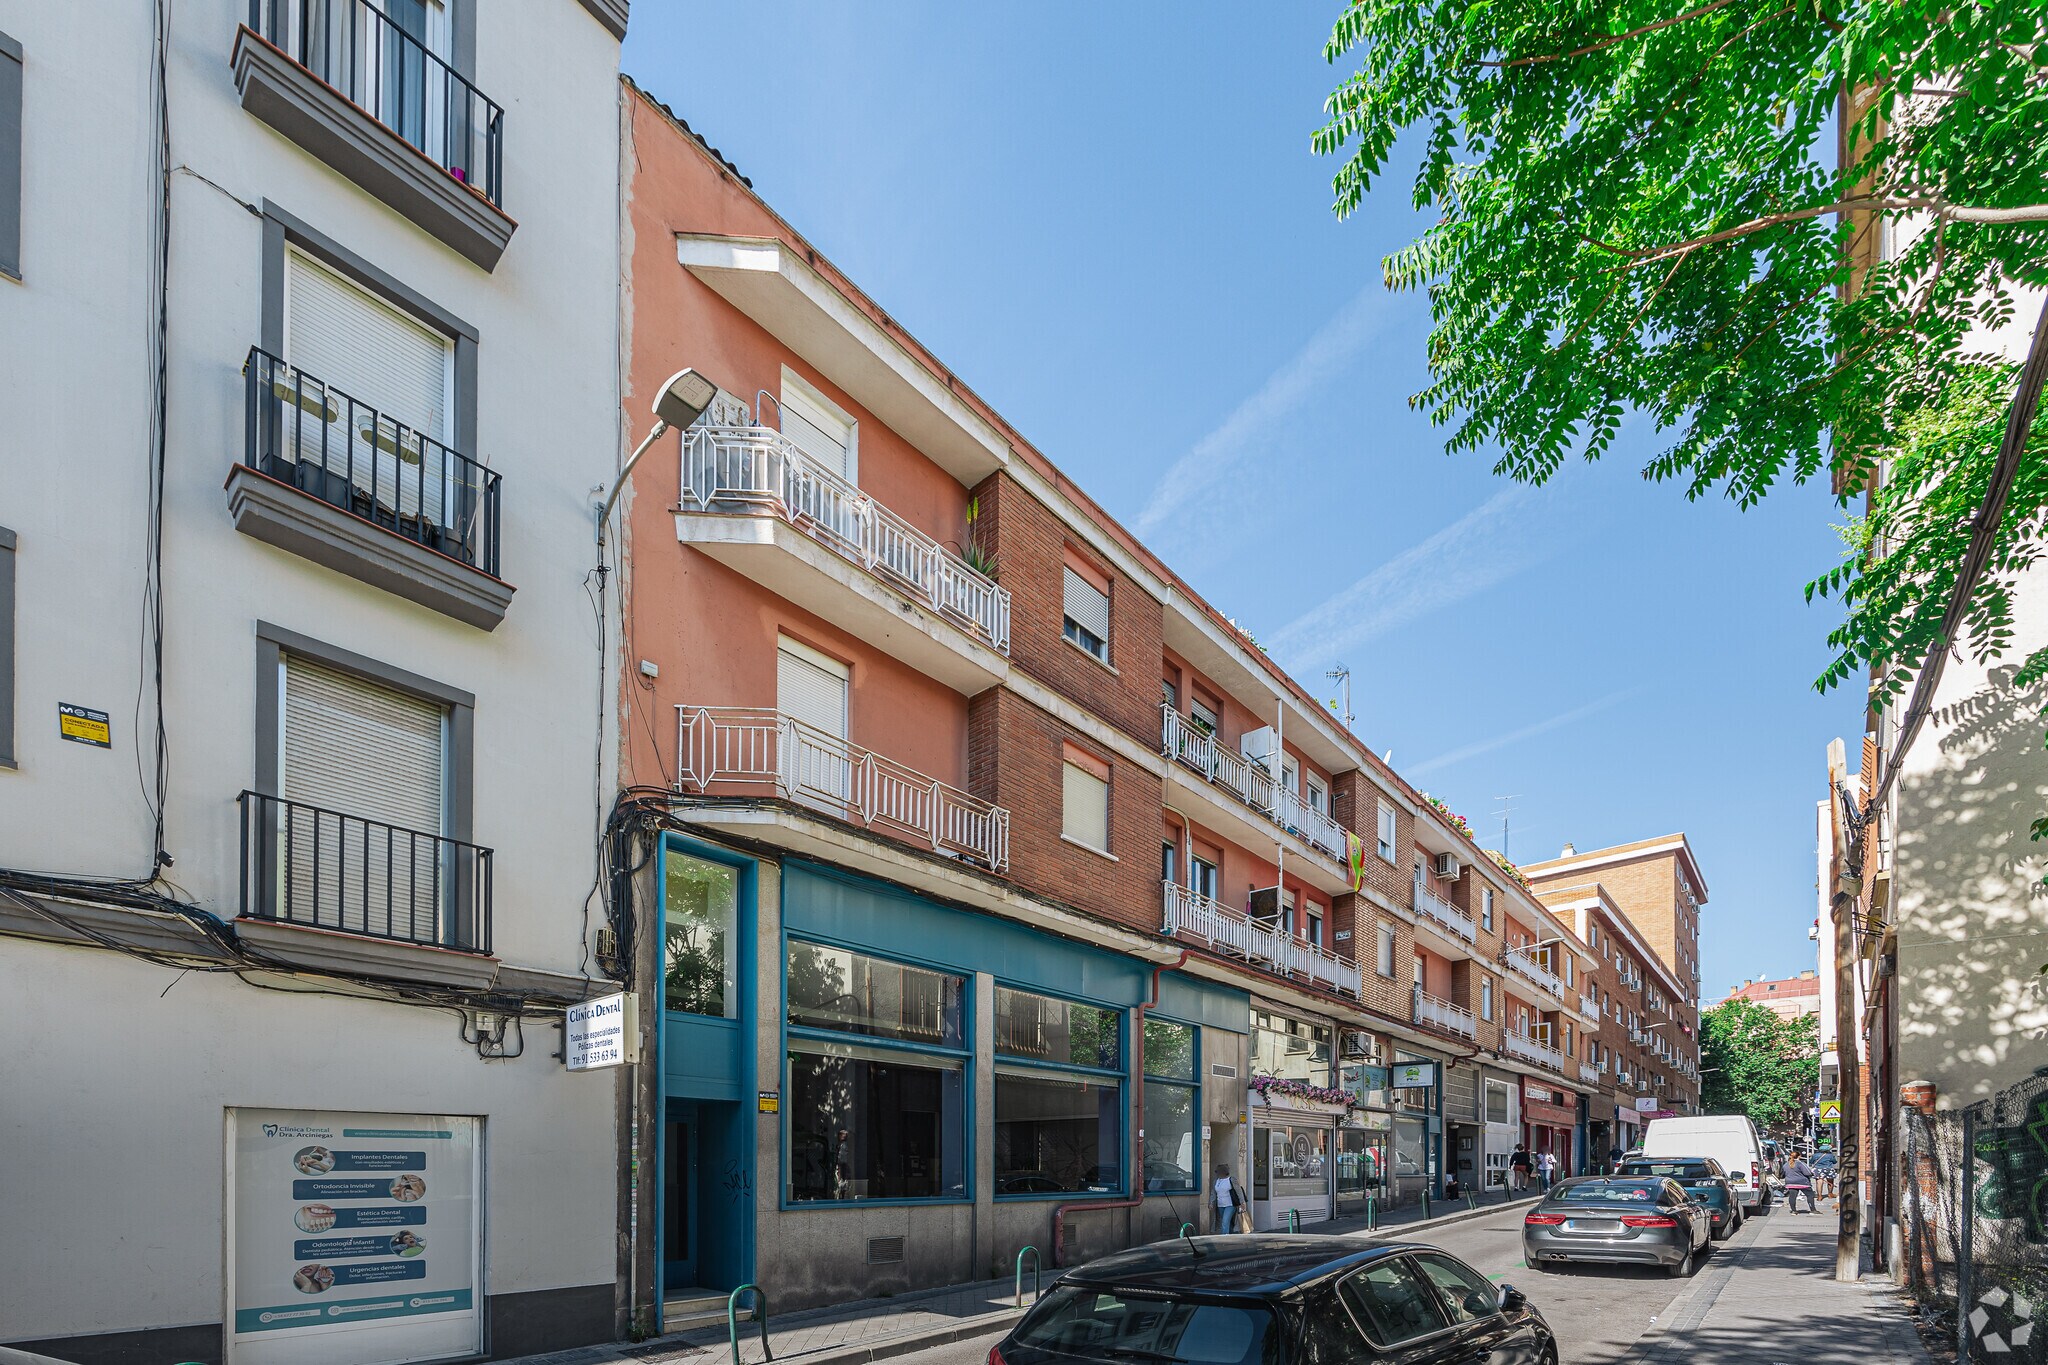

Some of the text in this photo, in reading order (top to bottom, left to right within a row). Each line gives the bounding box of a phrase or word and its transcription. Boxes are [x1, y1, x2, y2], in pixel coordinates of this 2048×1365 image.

[570, 1033, 582, 1042] Todas
[590, 1026, 620, 1038] especialidades
[578, 1038, 613, 1050] Pólizas dentales
[312, 1240, 352, 1248] Odontología
